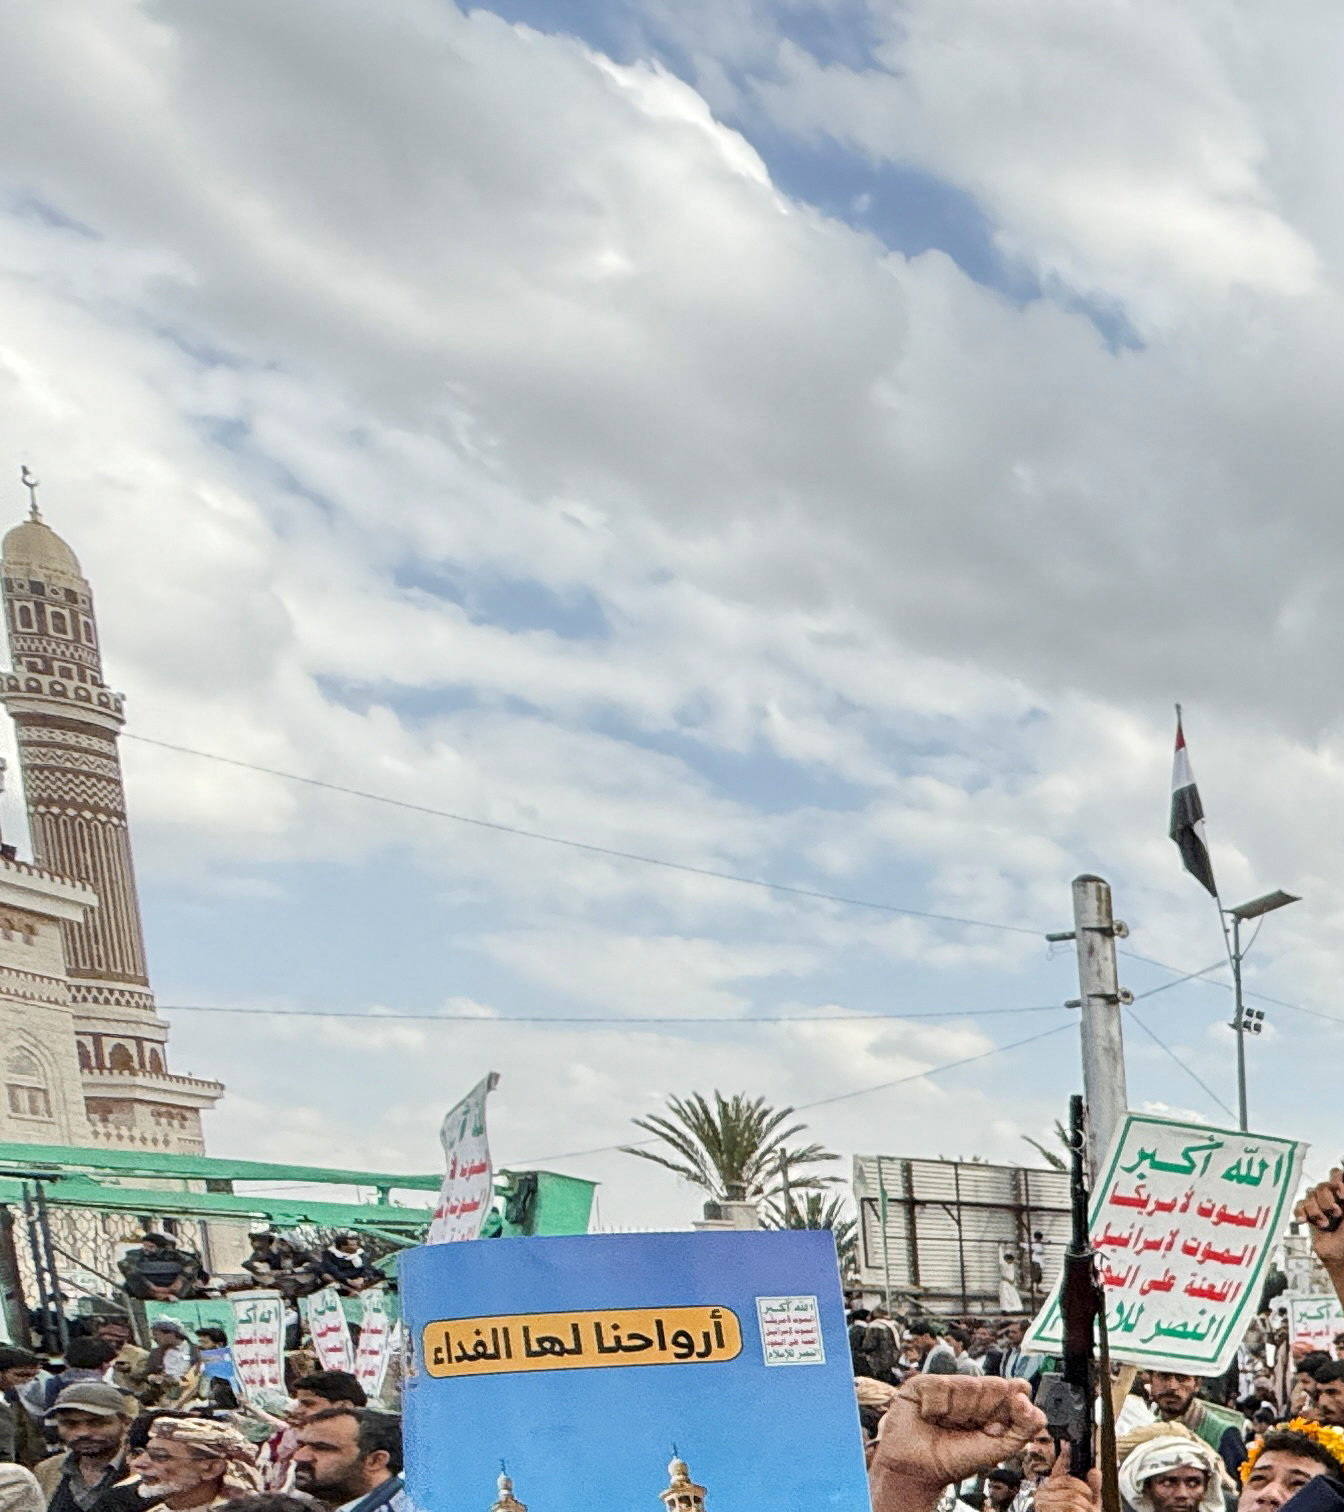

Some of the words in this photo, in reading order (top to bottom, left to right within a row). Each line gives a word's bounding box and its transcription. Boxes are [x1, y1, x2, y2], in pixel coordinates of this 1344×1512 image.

[1120, 1135, 1224, 1181] أكبر
[1221, 1147, 1284, 1187] الله
[1109, 1180, 1195, 1216] لأمريكا
[1197, 1197, 1271, 1230] الموت
[1181, 1237, 1257, 1268] الموت
[1139, 1266, 1177, 1296] على
[1183, 1272, 1242, 1303] اللعنة
[523, 1321, 583, 1358] لها
[594, 1308, 726, 1360] أرواحنا
[1139, 1307, 1226, 1344] النصر
[433, 1326, 513, 1366] الفداء
